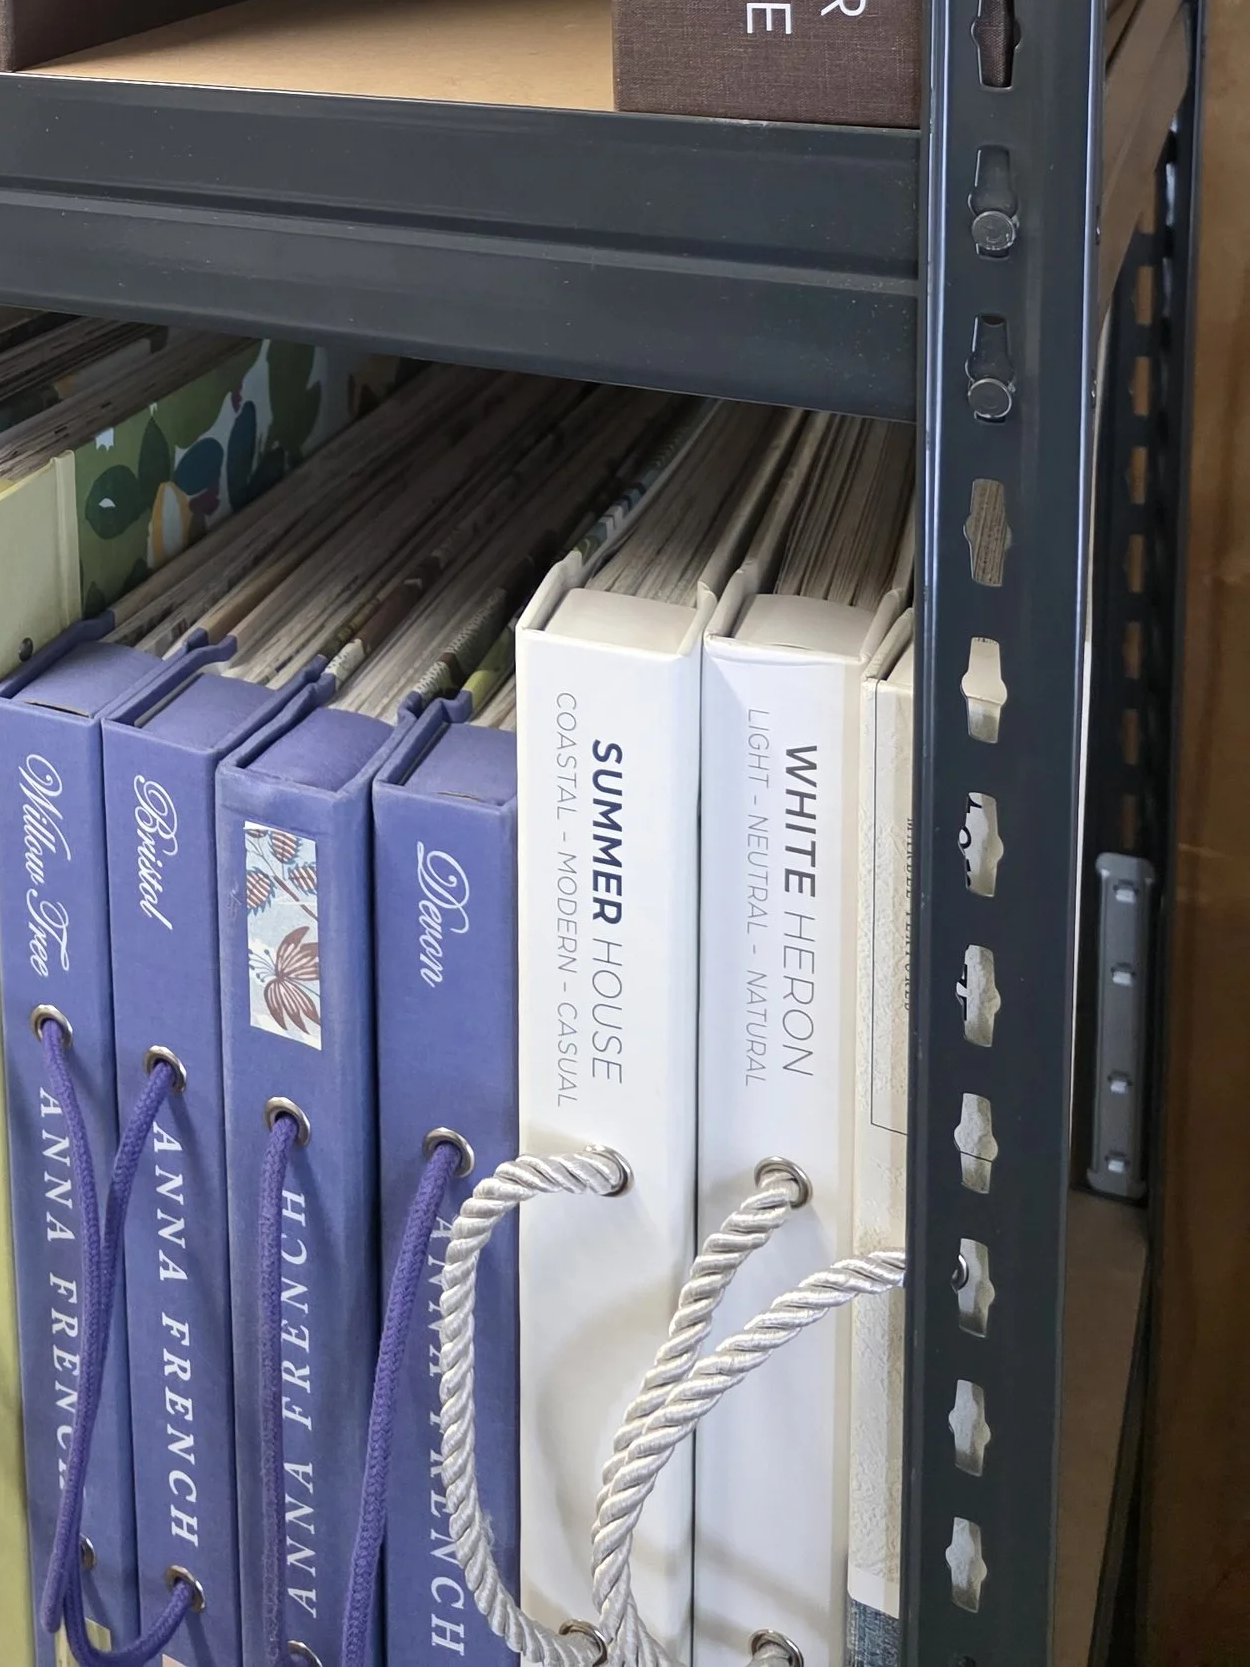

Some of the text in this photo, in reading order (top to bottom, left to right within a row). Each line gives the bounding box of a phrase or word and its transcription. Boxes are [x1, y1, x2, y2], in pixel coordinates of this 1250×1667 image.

[555, 691, 578, 821] COASTAL
[747, 707, 770, 789] LIGHT
[18, 752, 72, 978] Willow Tree
[133, 773, 179, 932] Bristol
[416, 840, 471, 989] Devon
[556, 851, 578, 974] MODERN
[591, 738, 624, 1085] SUMMER HOUSE
[746, 813, 769, 935] NEUTRAL
[781, 744, 818, 1077] WHITE HERON
[556, 1001, 578, 1108] CASUAL
[745, 969, 768, 1088] NATURAL
[40, 1087, 80, 1491] ANNA FRENC
[153, 1121, 198, 1548] ANNA FRENCH
[281, 1189, 318, 1619] ANNA FRENCH
